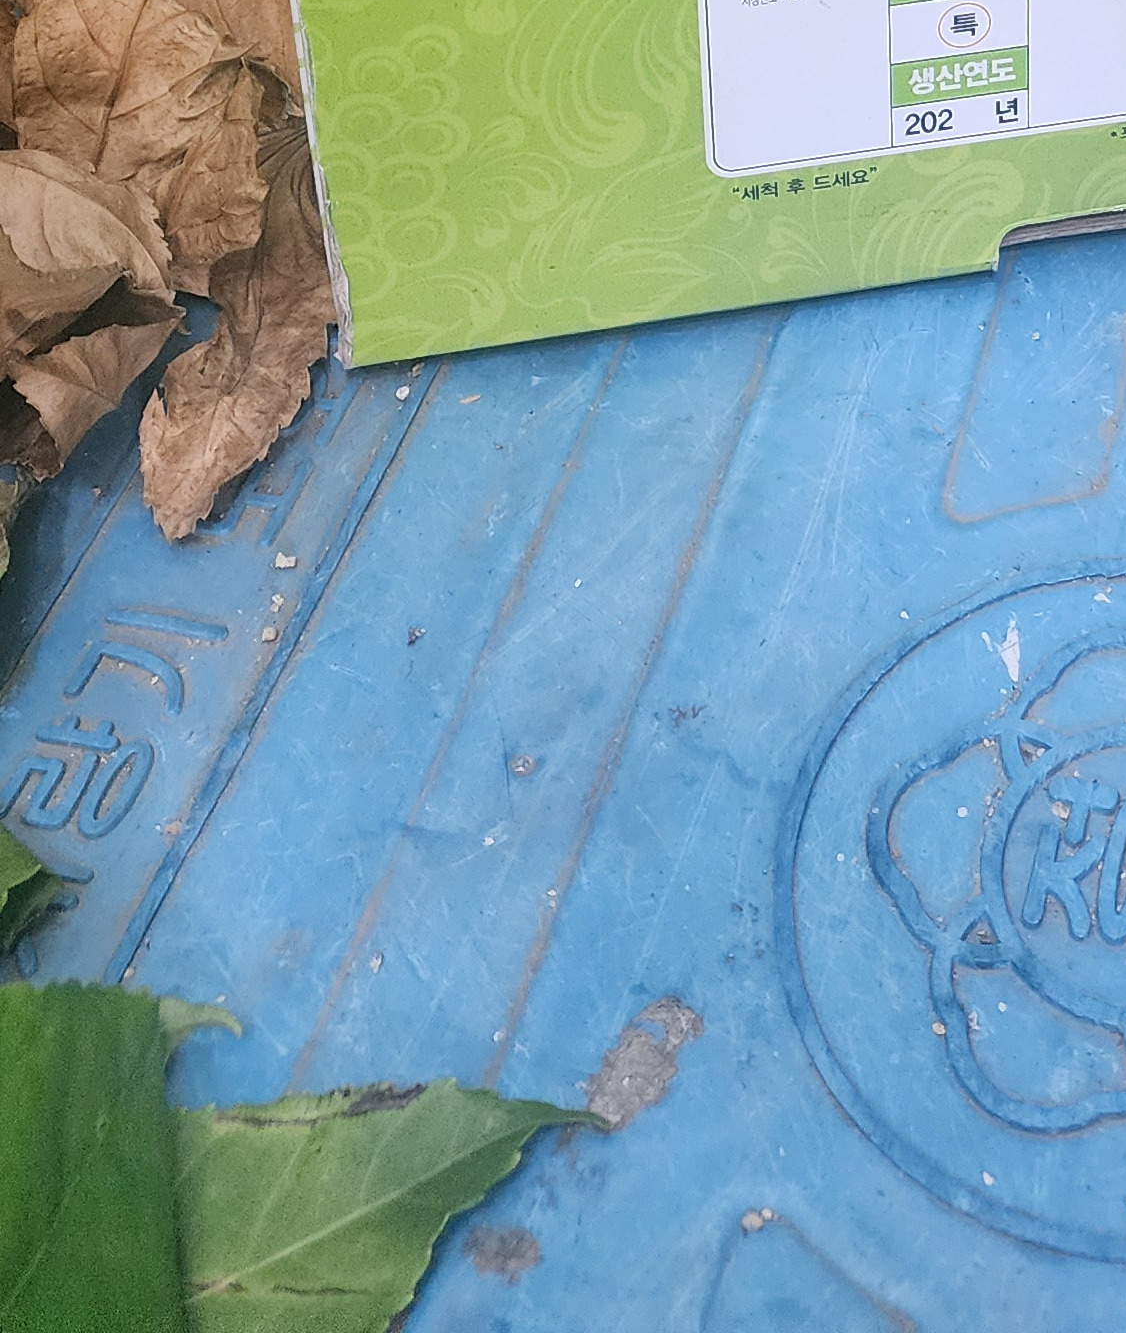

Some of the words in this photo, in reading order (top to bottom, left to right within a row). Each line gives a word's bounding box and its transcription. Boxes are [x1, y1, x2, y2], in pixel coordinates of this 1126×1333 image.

[950, 12, 978, 37] 특
[908, 57, 1017, 96] 생산연도
[905, 108, 953, 136] 202
[995, 97, 1018, 124] 년
[786, 178, 805, 195] 후
